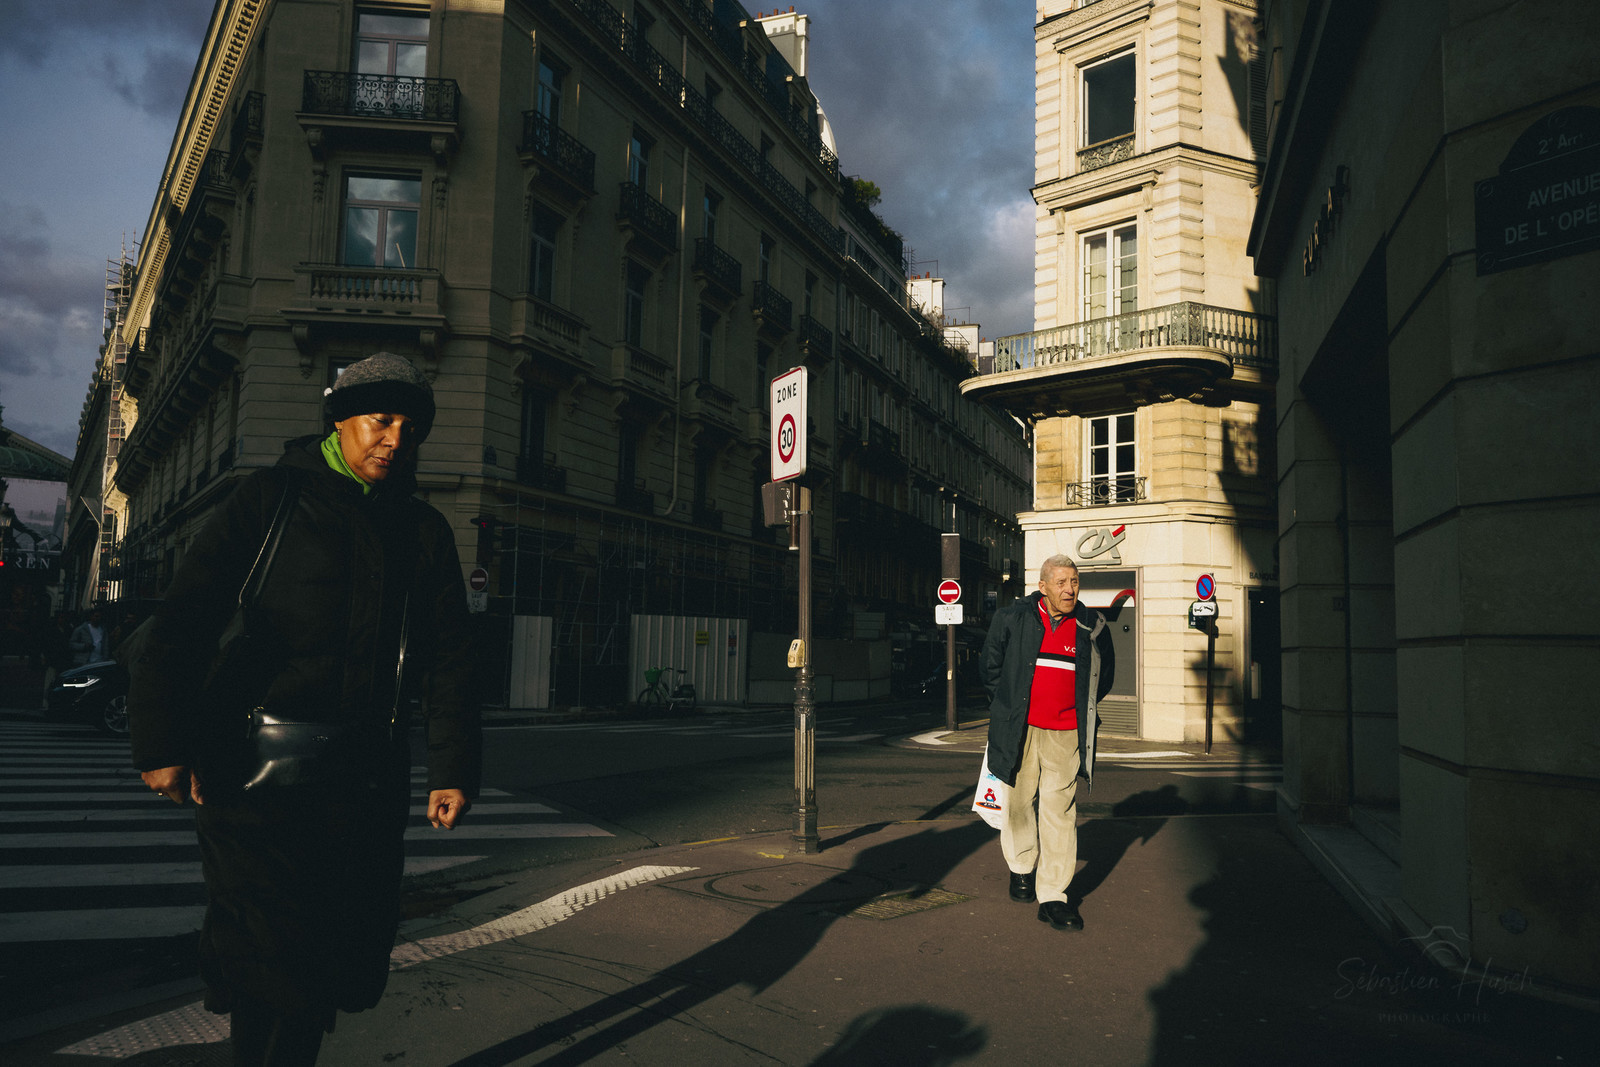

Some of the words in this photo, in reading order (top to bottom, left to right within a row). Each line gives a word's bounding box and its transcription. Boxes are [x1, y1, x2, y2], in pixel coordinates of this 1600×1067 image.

[1527, 172, 1600, 210] AVENUE
[1504, 222, 1529, 246] DE
[1536, 200, 1600, 237] L'OPÉ
[777, 382, 797, 403] ZONE
[781, 427, 793, 449] 30
[6, 556, 50, 569] REN
